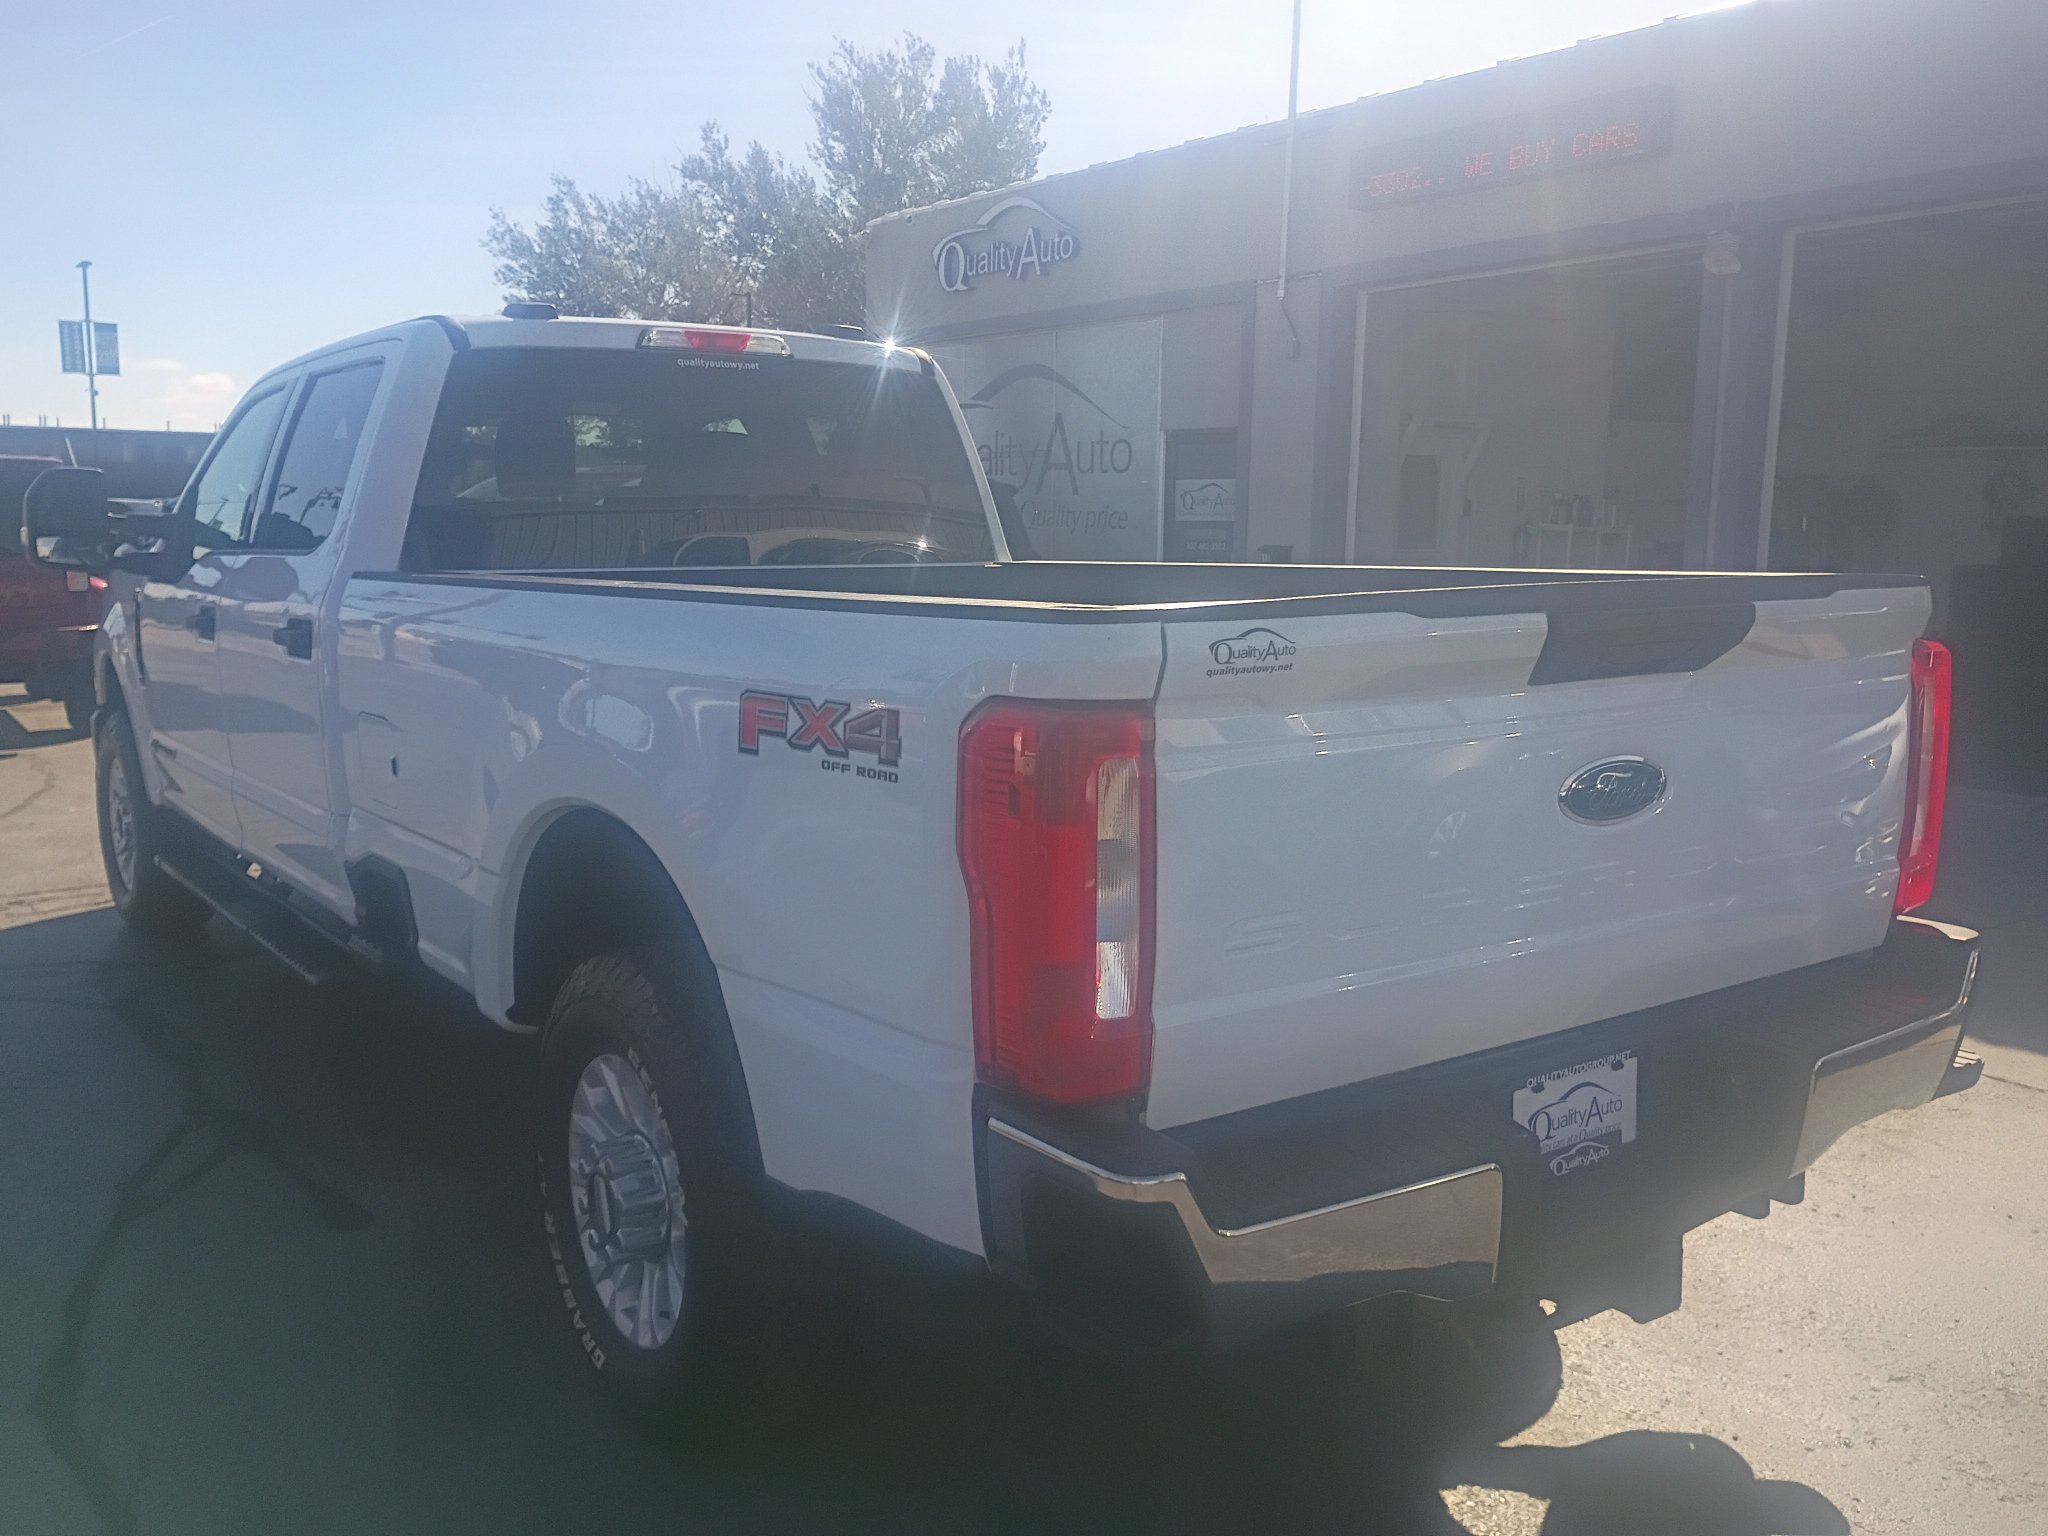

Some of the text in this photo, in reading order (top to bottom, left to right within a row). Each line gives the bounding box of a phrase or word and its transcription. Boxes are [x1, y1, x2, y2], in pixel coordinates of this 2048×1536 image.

[1463, 152, 1493, 178] WE
[1509, 137, 1556, 171] BUY
[1573, 120, 1641, 157] CARS
[677, 358, 760, 370] qualityautowy.net
[1084, 506, 1129, 534] price
[1206, 663, 1294, 678] qualityautowy.net
[738, 688, 902, 768] FX4
[821, 759, 899, 783] OFF ROAD
[1526, 1049, 1632, 1089] QUALITYAUTOGROUP.NET
